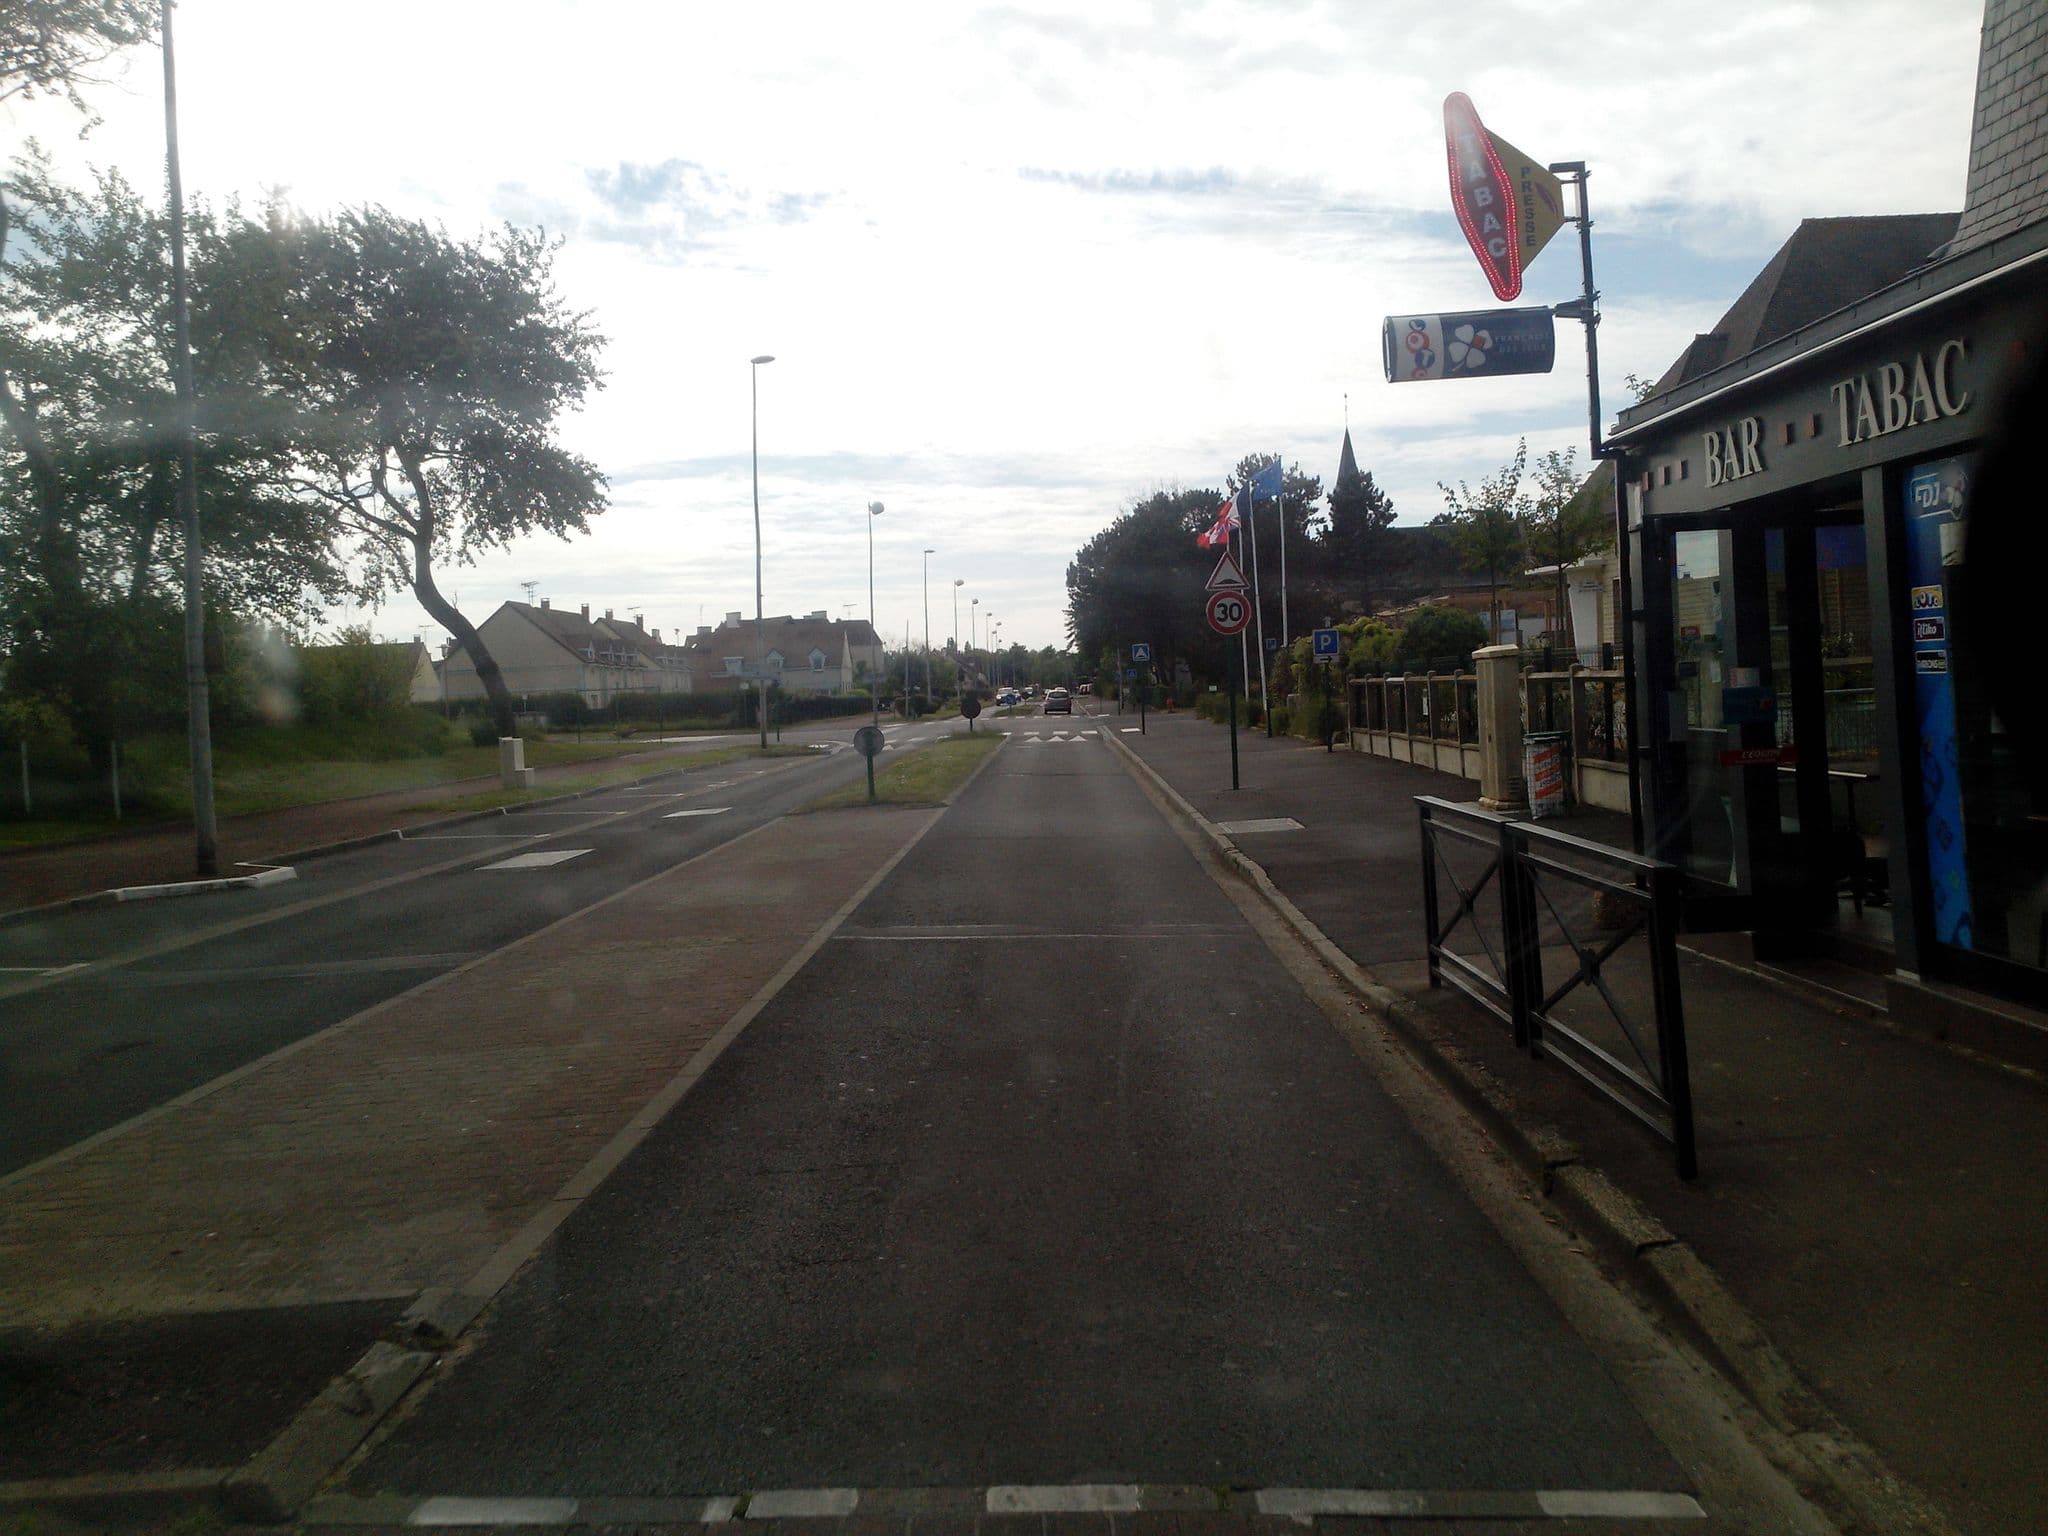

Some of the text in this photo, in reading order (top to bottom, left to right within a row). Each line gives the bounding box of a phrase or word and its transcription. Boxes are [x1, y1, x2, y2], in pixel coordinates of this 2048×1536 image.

[1458, 133, 1507, 258] TABAC
[1520, 166, 1537, 247] PRESSE
[1702, 338, 1969, 488] BAR TABAC
[1915, 481, 1941, 507] FDJ
[1216, 602, 1242, 622] 30
[1320, 634, 1332, 651] P
